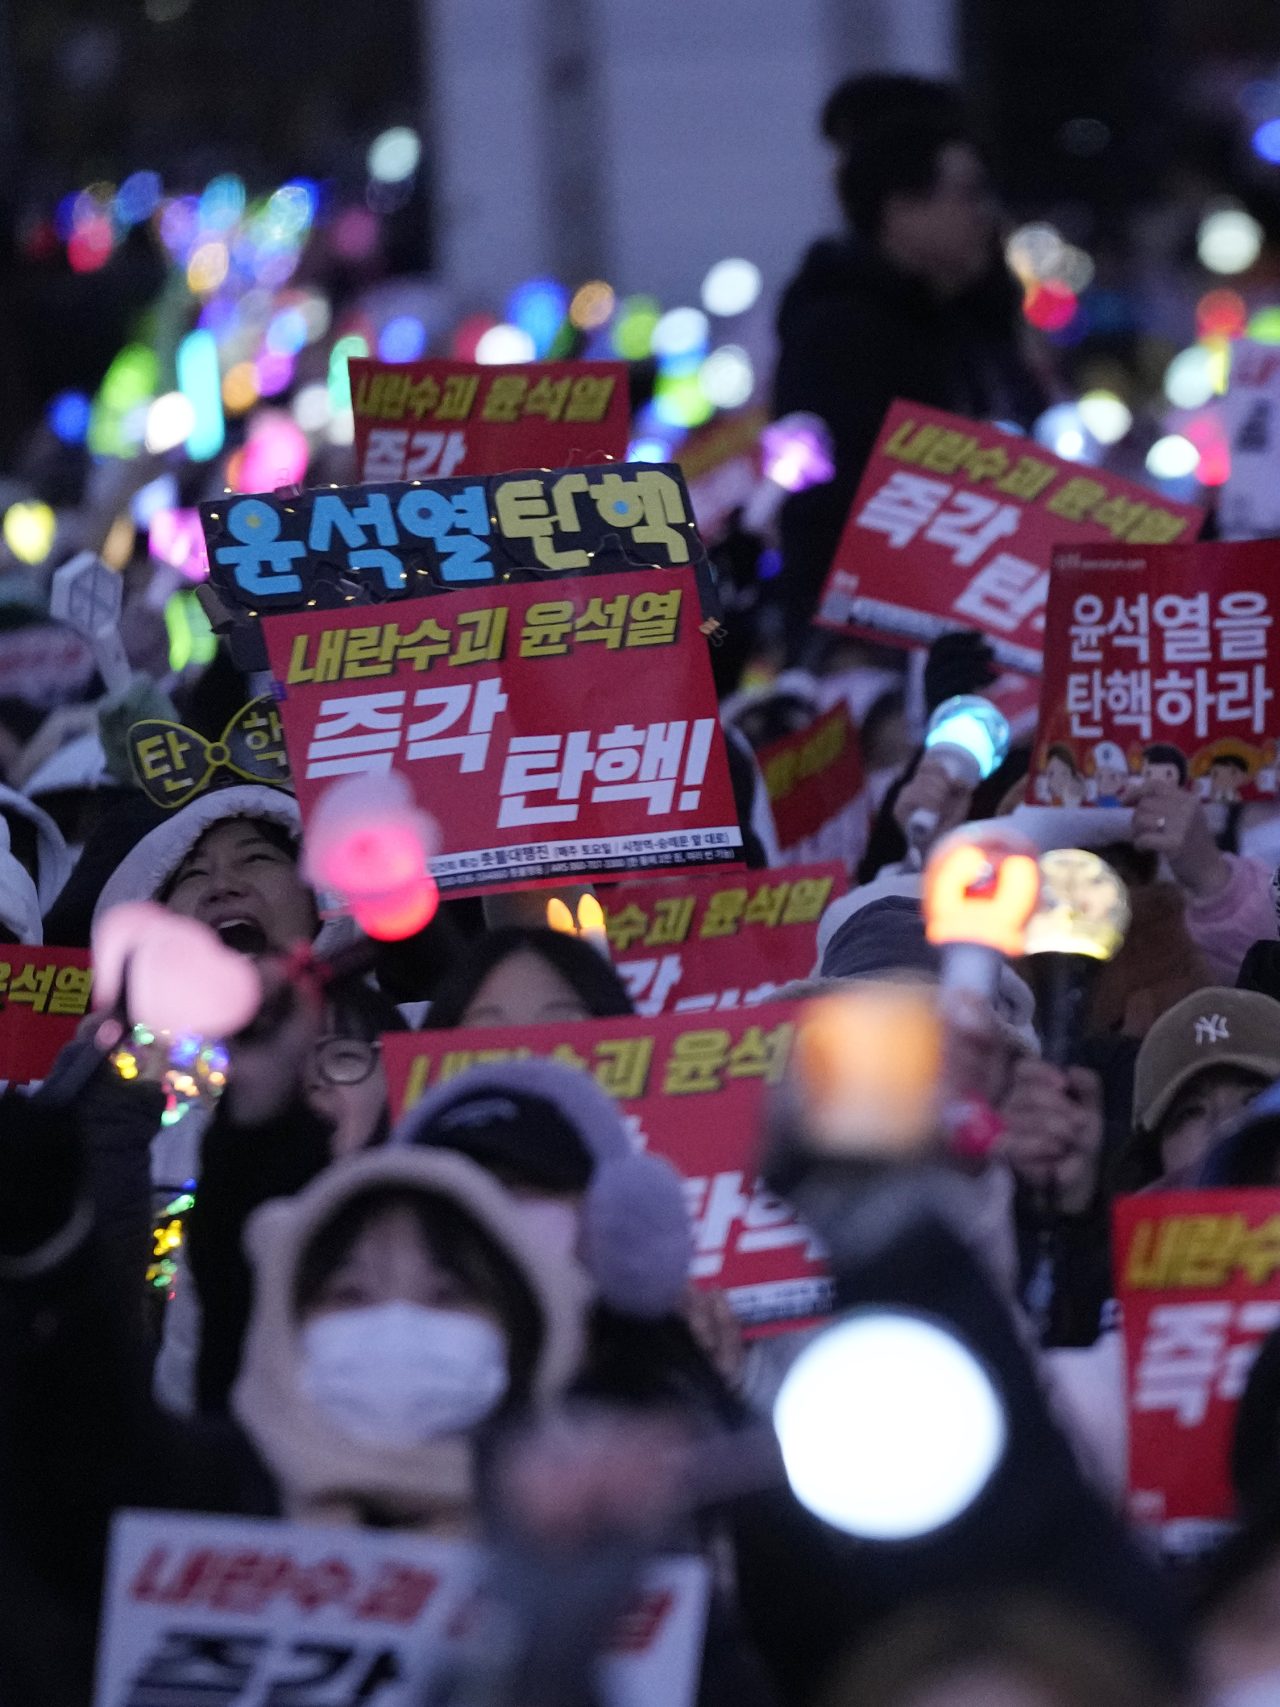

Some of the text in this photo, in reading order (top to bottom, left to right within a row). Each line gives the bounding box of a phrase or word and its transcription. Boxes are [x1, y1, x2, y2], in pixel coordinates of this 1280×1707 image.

[884, 419, 1059, 500] 내란수괴
[856, 470, 1022, 568] 즉각
[286, 588, 684, 685] 내란수괴 윤석열
[1068, 590, 1274, 664] 윤석열을
[305, 677, 510, 780] 즉각
[1066, 663, 1275, 740] 탄핵하라
[495, 717, 716, 831] 탄핵!
[604, 877, 834, 951] 수괴 윤석열
[662, 1019, 796, 1096] 윤석
[1194, 1013, 1230, 1043] NY
